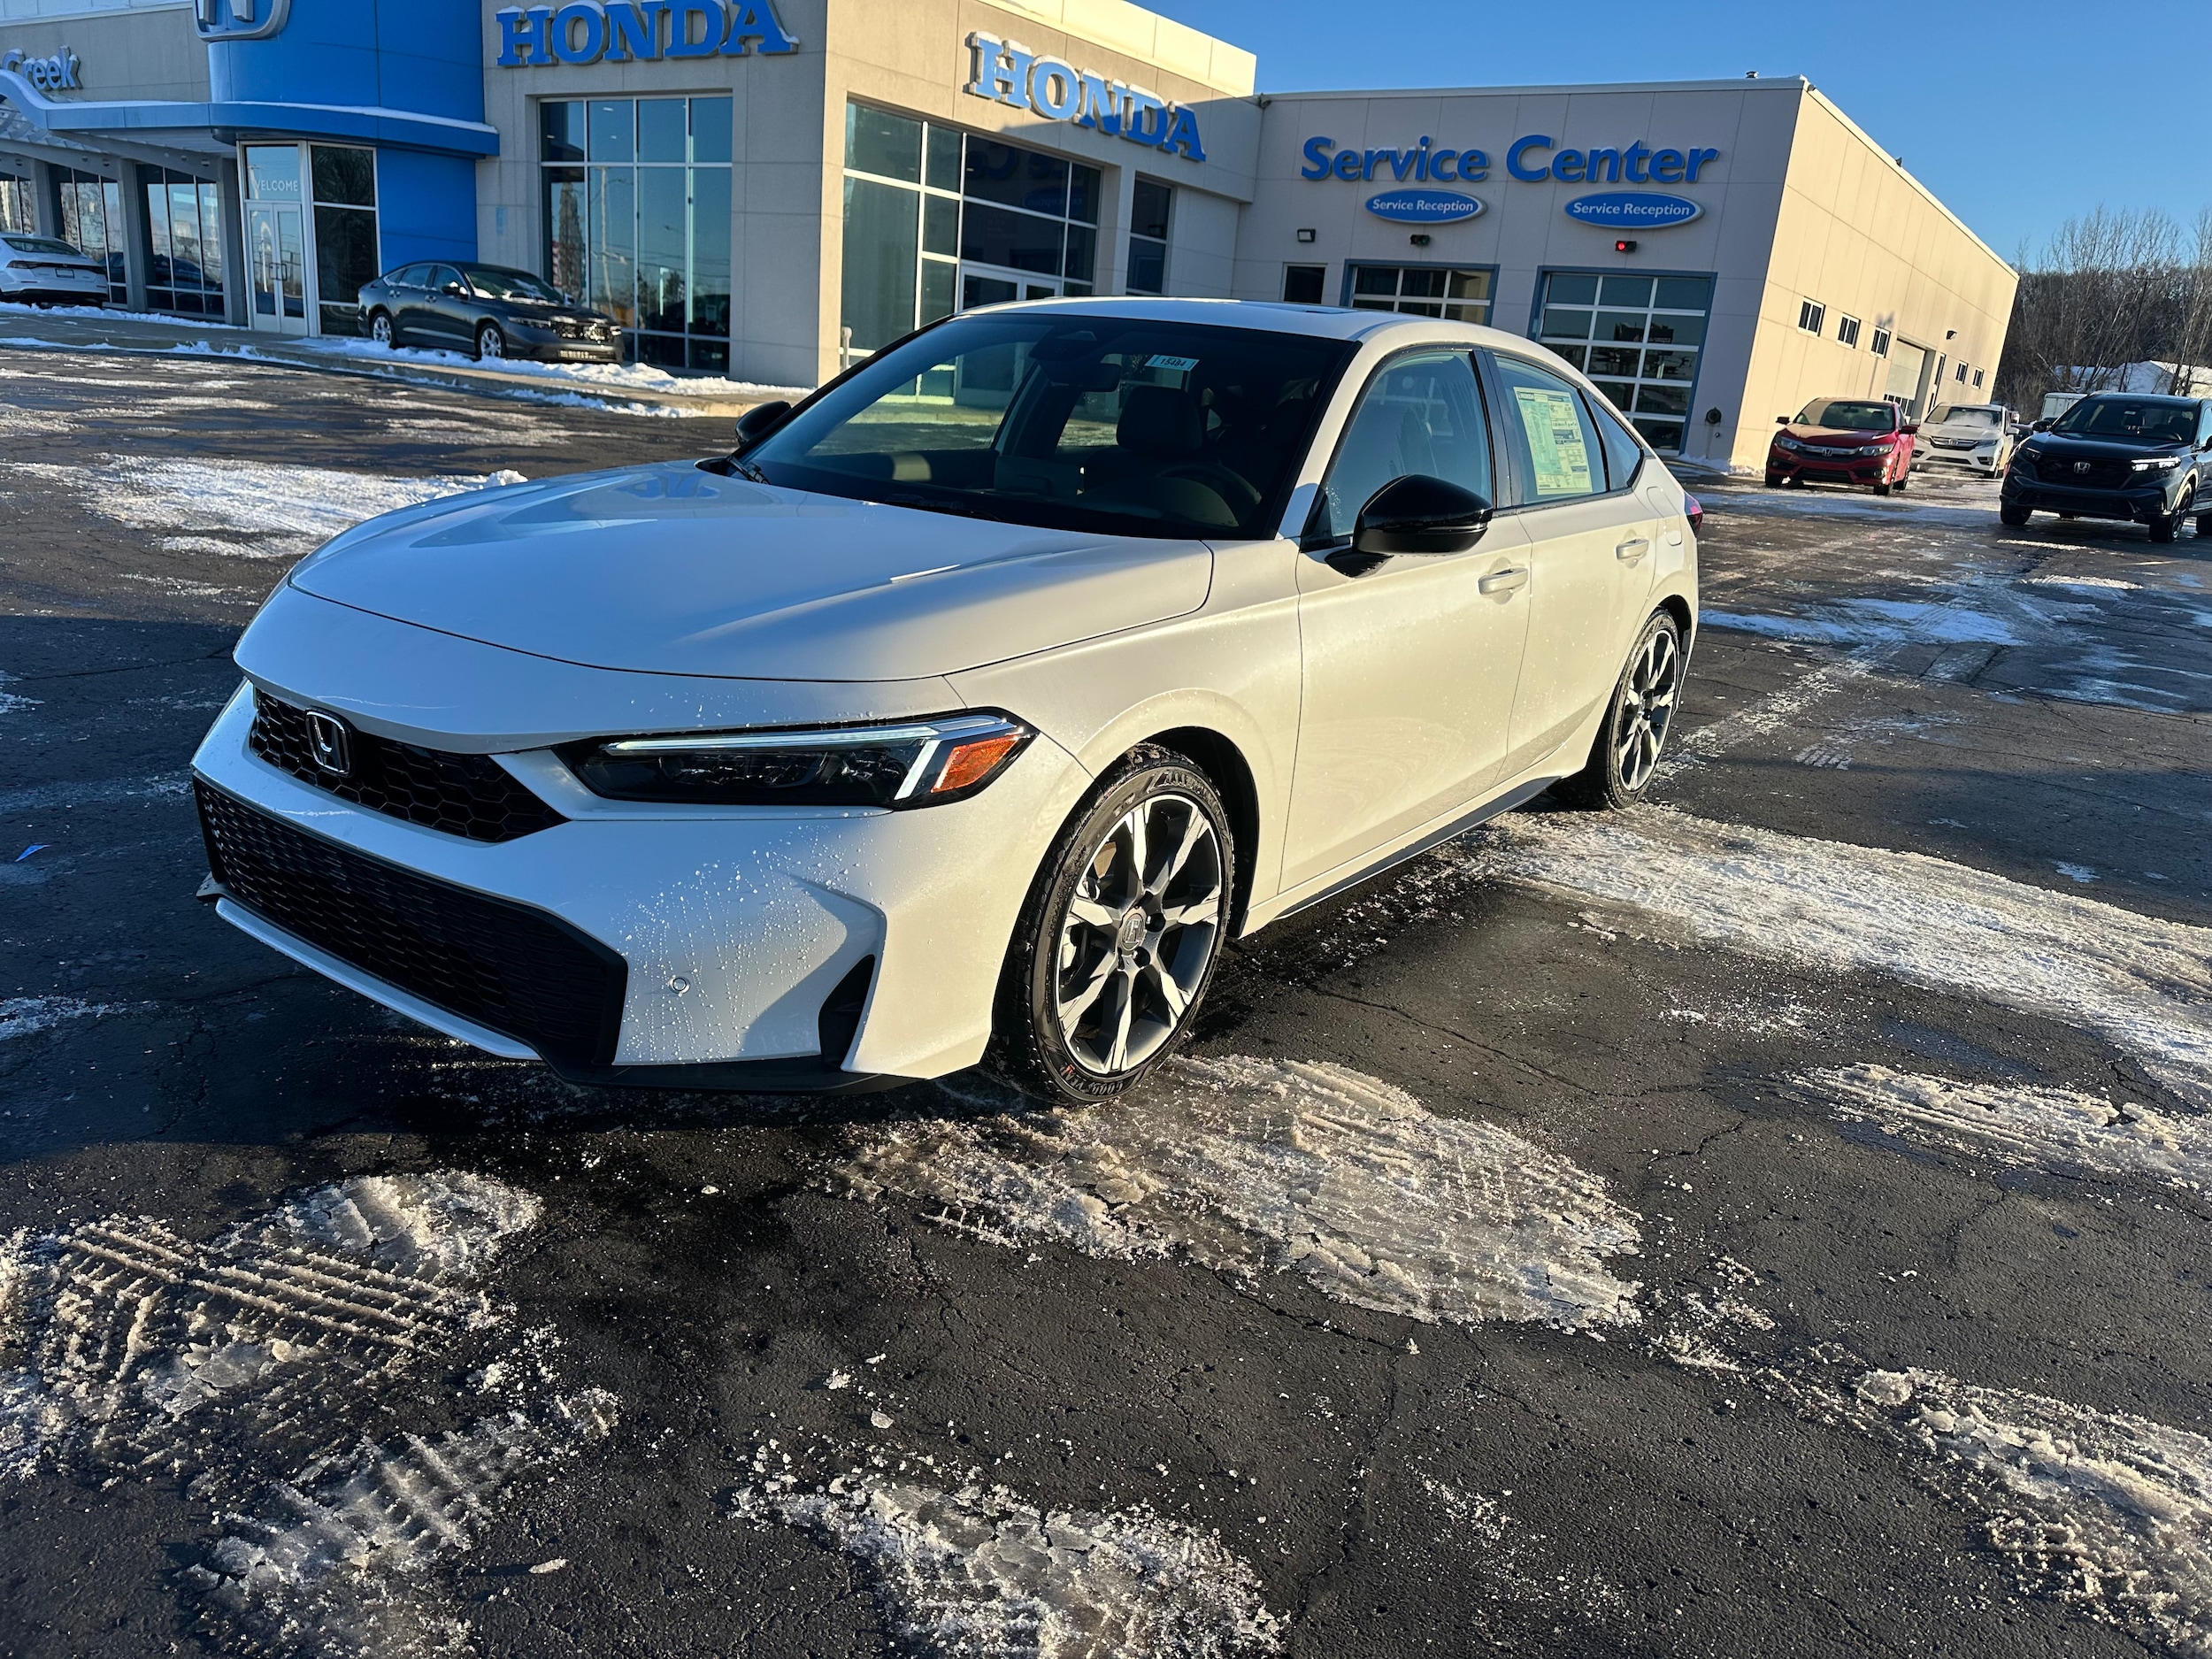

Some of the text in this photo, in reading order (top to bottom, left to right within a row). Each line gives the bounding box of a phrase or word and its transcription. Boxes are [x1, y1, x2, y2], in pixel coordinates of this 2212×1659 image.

[495, 0, 799, 67] HONDA
[964, 31, 1206, 161] HONDA
[1301, 134, 1718, 183] Service Center
[1372, 199, 1474, 214] Service Reception
[1573, 203, 1689, 218] Service Reception
